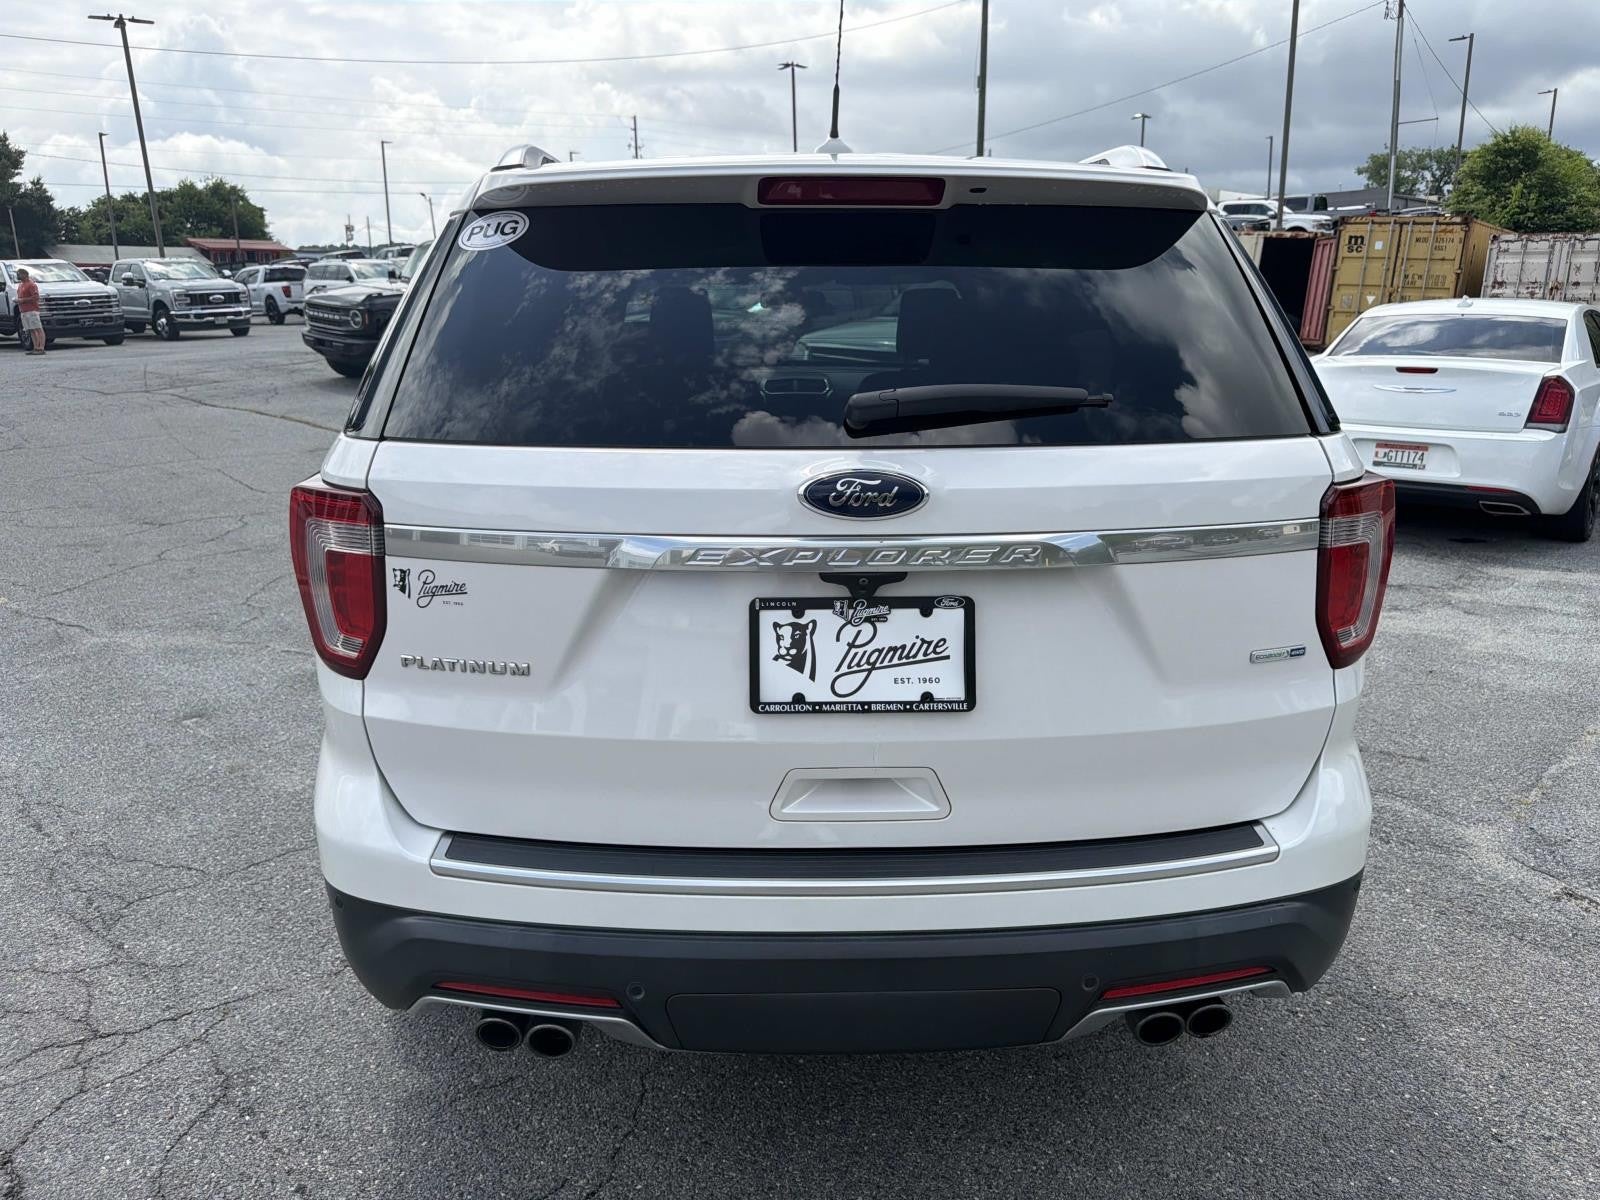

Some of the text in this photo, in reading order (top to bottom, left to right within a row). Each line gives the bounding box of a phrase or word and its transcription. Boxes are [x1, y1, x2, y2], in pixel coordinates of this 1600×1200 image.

[466, 219, 520, 242] PUG
[828, 477, 900, 508] Ford
[684, 543, 1044, 567] EXPLORER
[416, 569, 468, 609] Pugmire
[851, 598, 891, 626] Pugmire
[399, 653, 531, 677] PLATINUM
[830, 621, 951, 698] Pugmire
[893, 677, 914, 685] EST.
[758, 702, 969, 712] CARROLLTON MARIETTA BREMEN CARTERSVILLE
